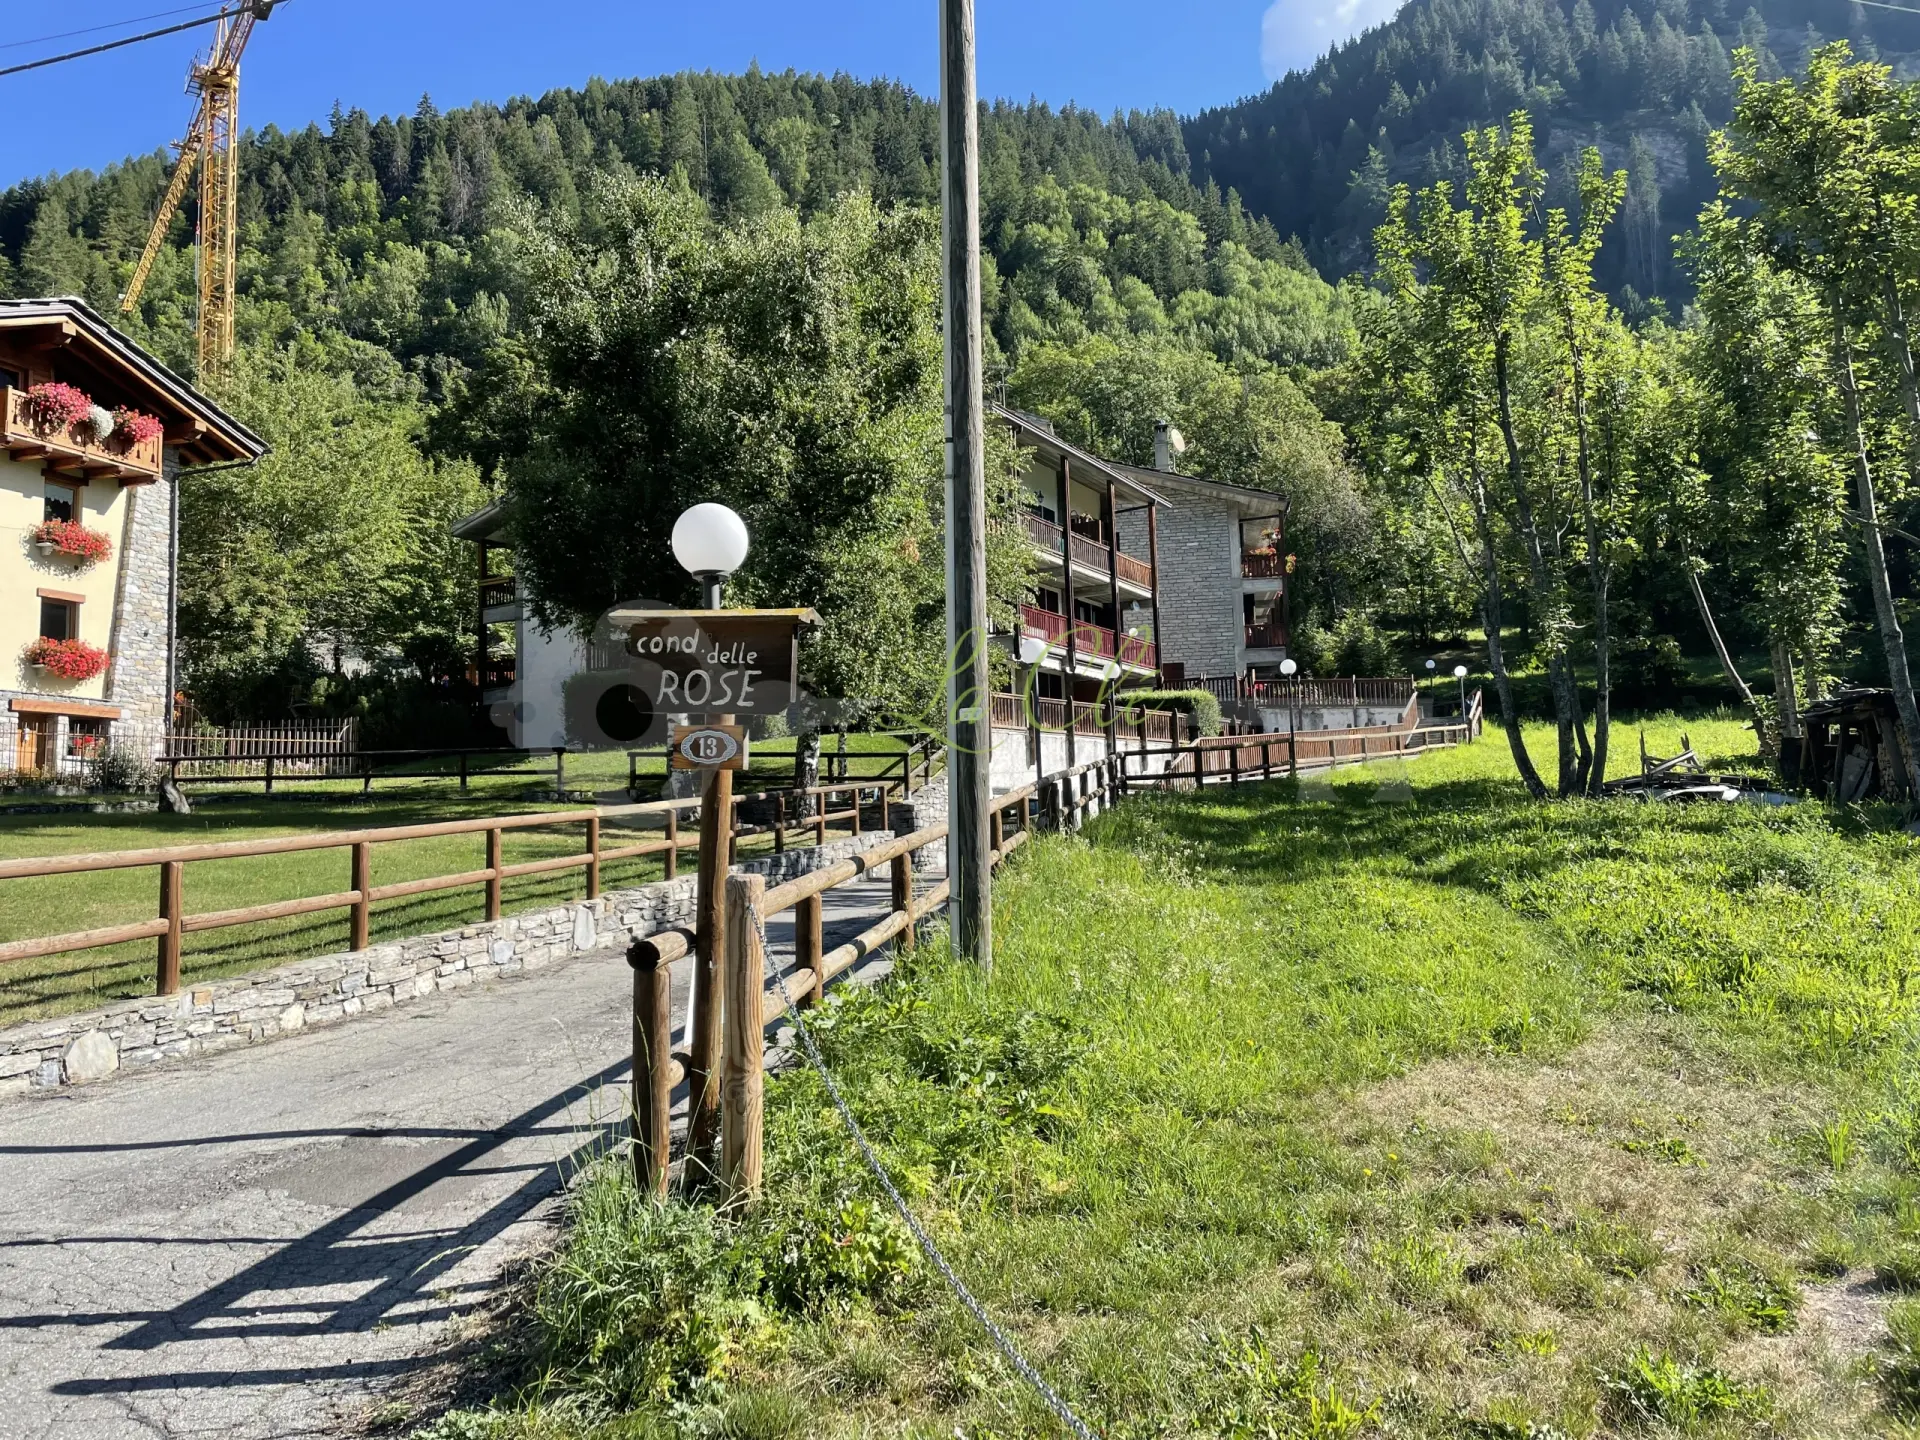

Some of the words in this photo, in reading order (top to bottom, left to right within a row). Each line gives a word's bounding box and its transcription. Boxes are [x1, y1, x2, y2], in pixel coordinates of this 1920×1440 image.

[706, 642, 758, 664] delle
[656, 669, 762, 706] ROSE
[698, 737, 718, 758] 13
